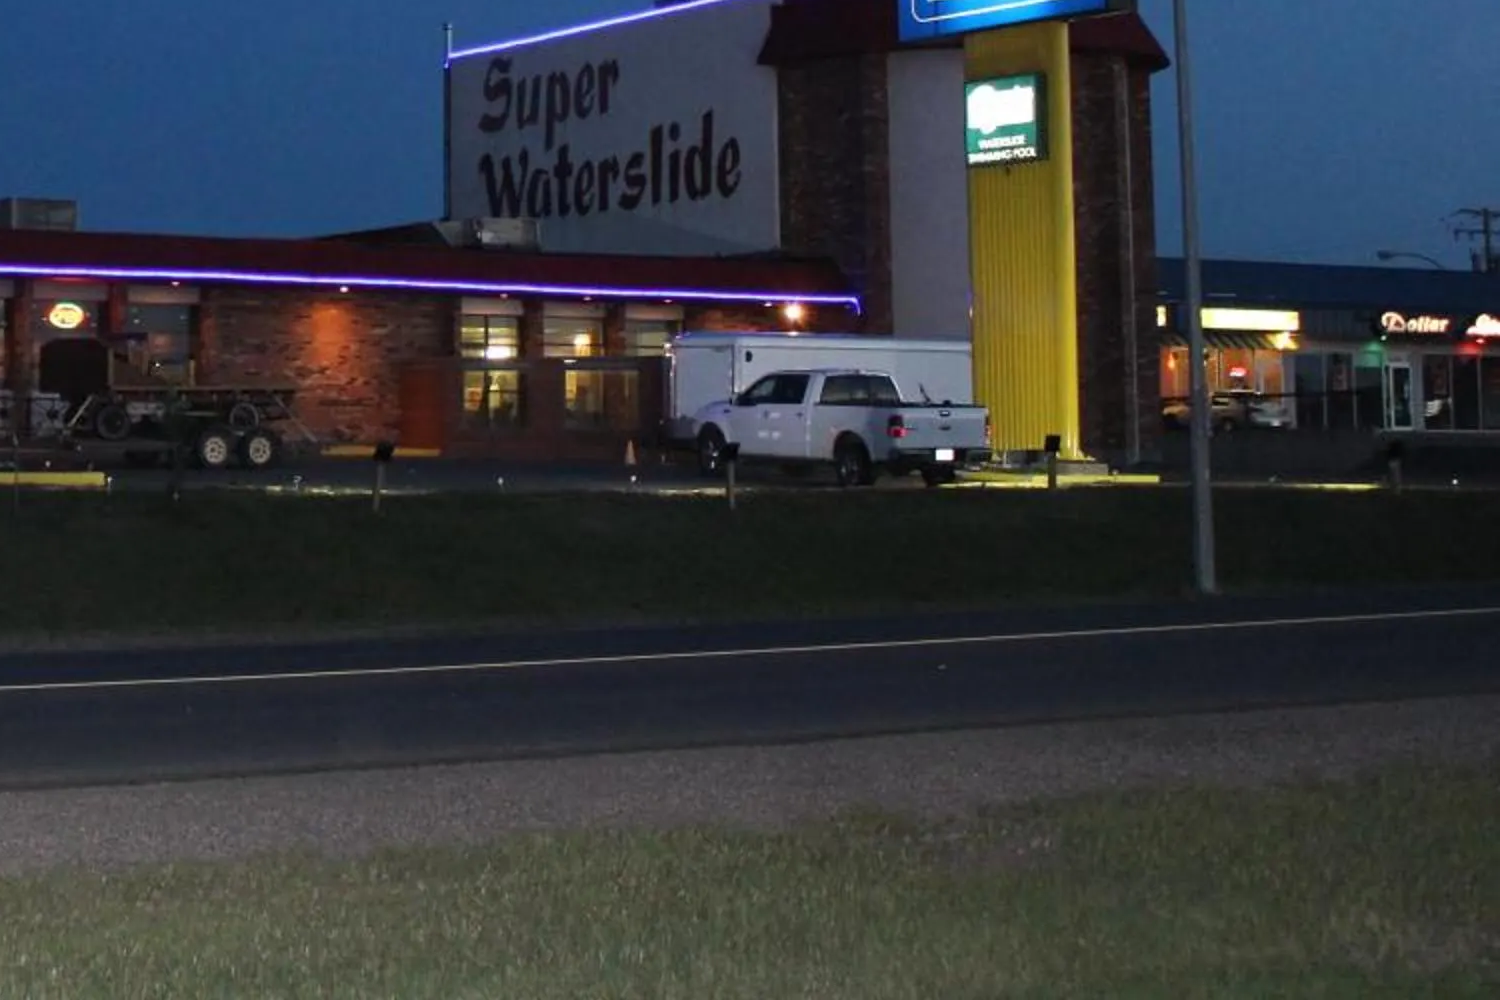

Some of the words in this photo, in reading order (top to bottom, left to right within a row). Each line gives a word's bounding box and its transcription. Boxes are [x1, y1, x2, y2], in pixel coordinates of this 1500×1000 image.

[478, 56, 619, 152] Super
[478, 106, 742, 218] Waterslide
[1381, 311, 1449, 333] Dollar
